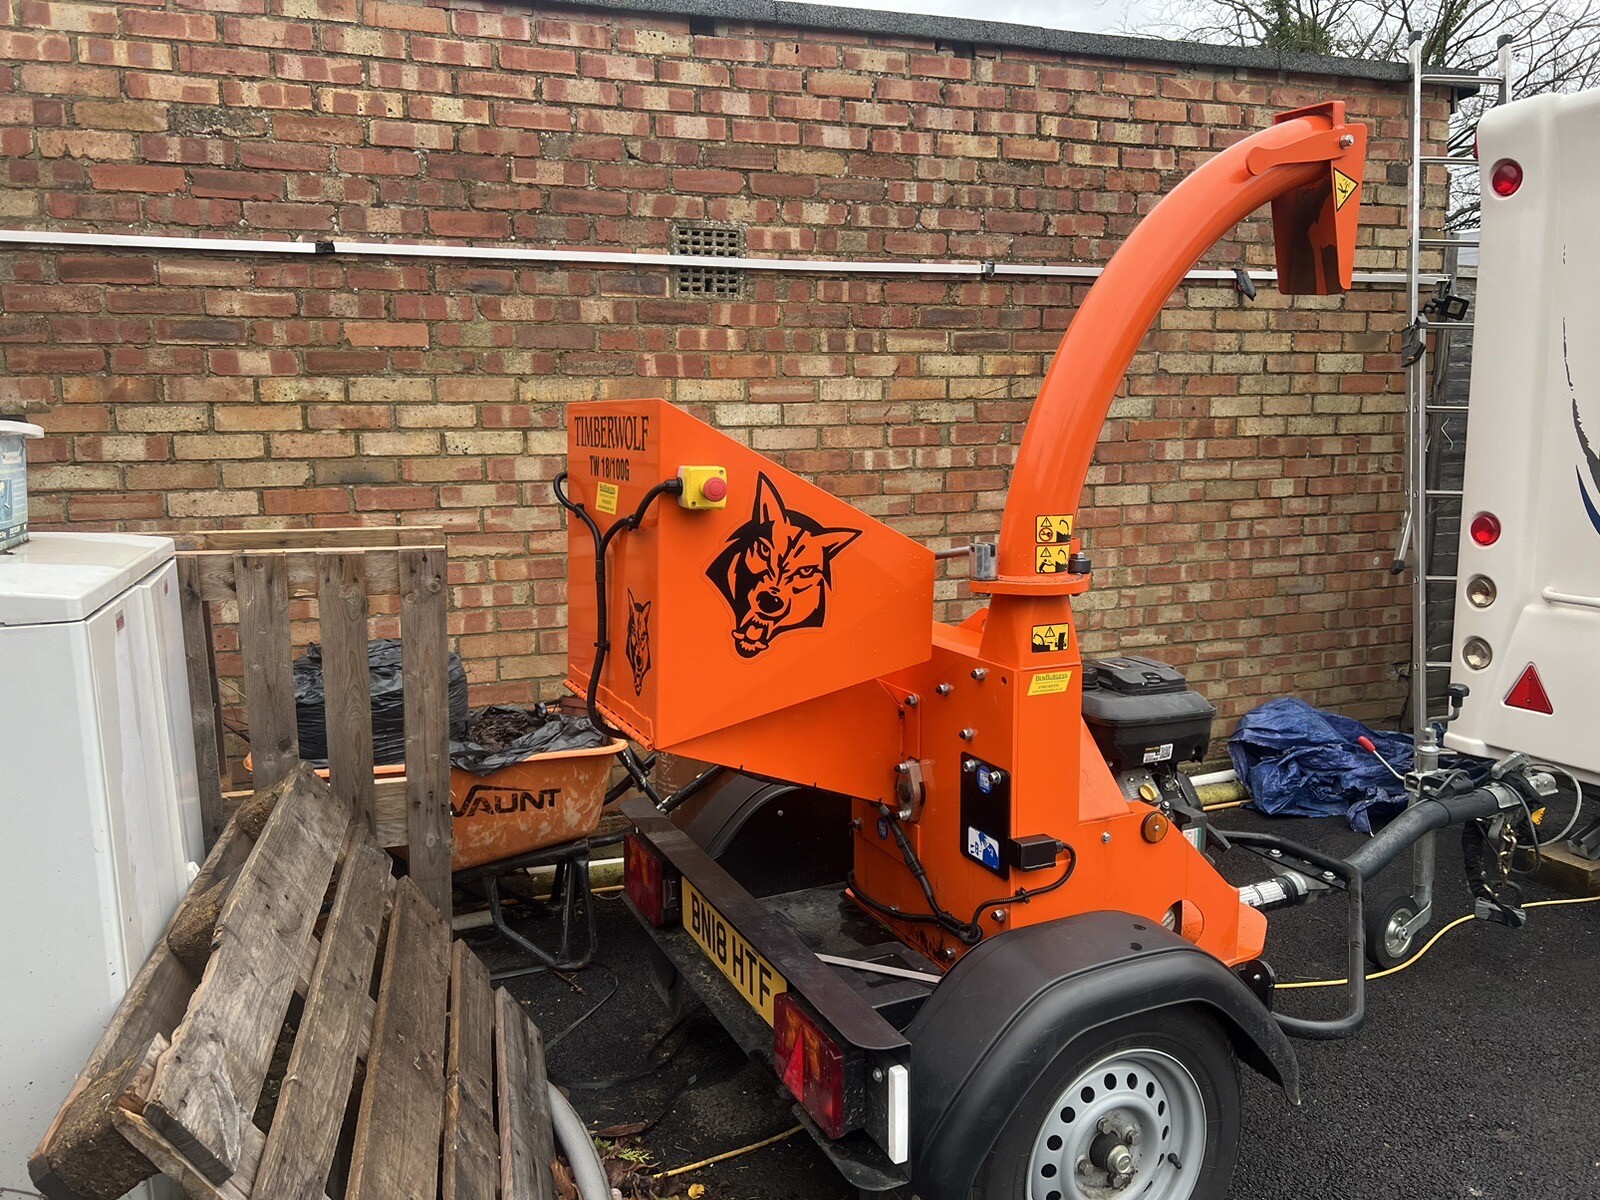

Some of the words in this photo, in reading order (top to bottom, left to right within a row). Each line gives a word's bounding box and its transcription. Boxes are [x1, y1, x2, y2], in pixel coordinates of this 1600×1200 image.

[574, 415, 650, 451] TIMBERWOLF
[589, 455, 600, 477] TW
[601, 456, 630, 481] 18/100G
[449, 784, 561, 818] VAUNT
[691, 891, 727, 966] BN18
[732, 935, 772, 1008] HTF
